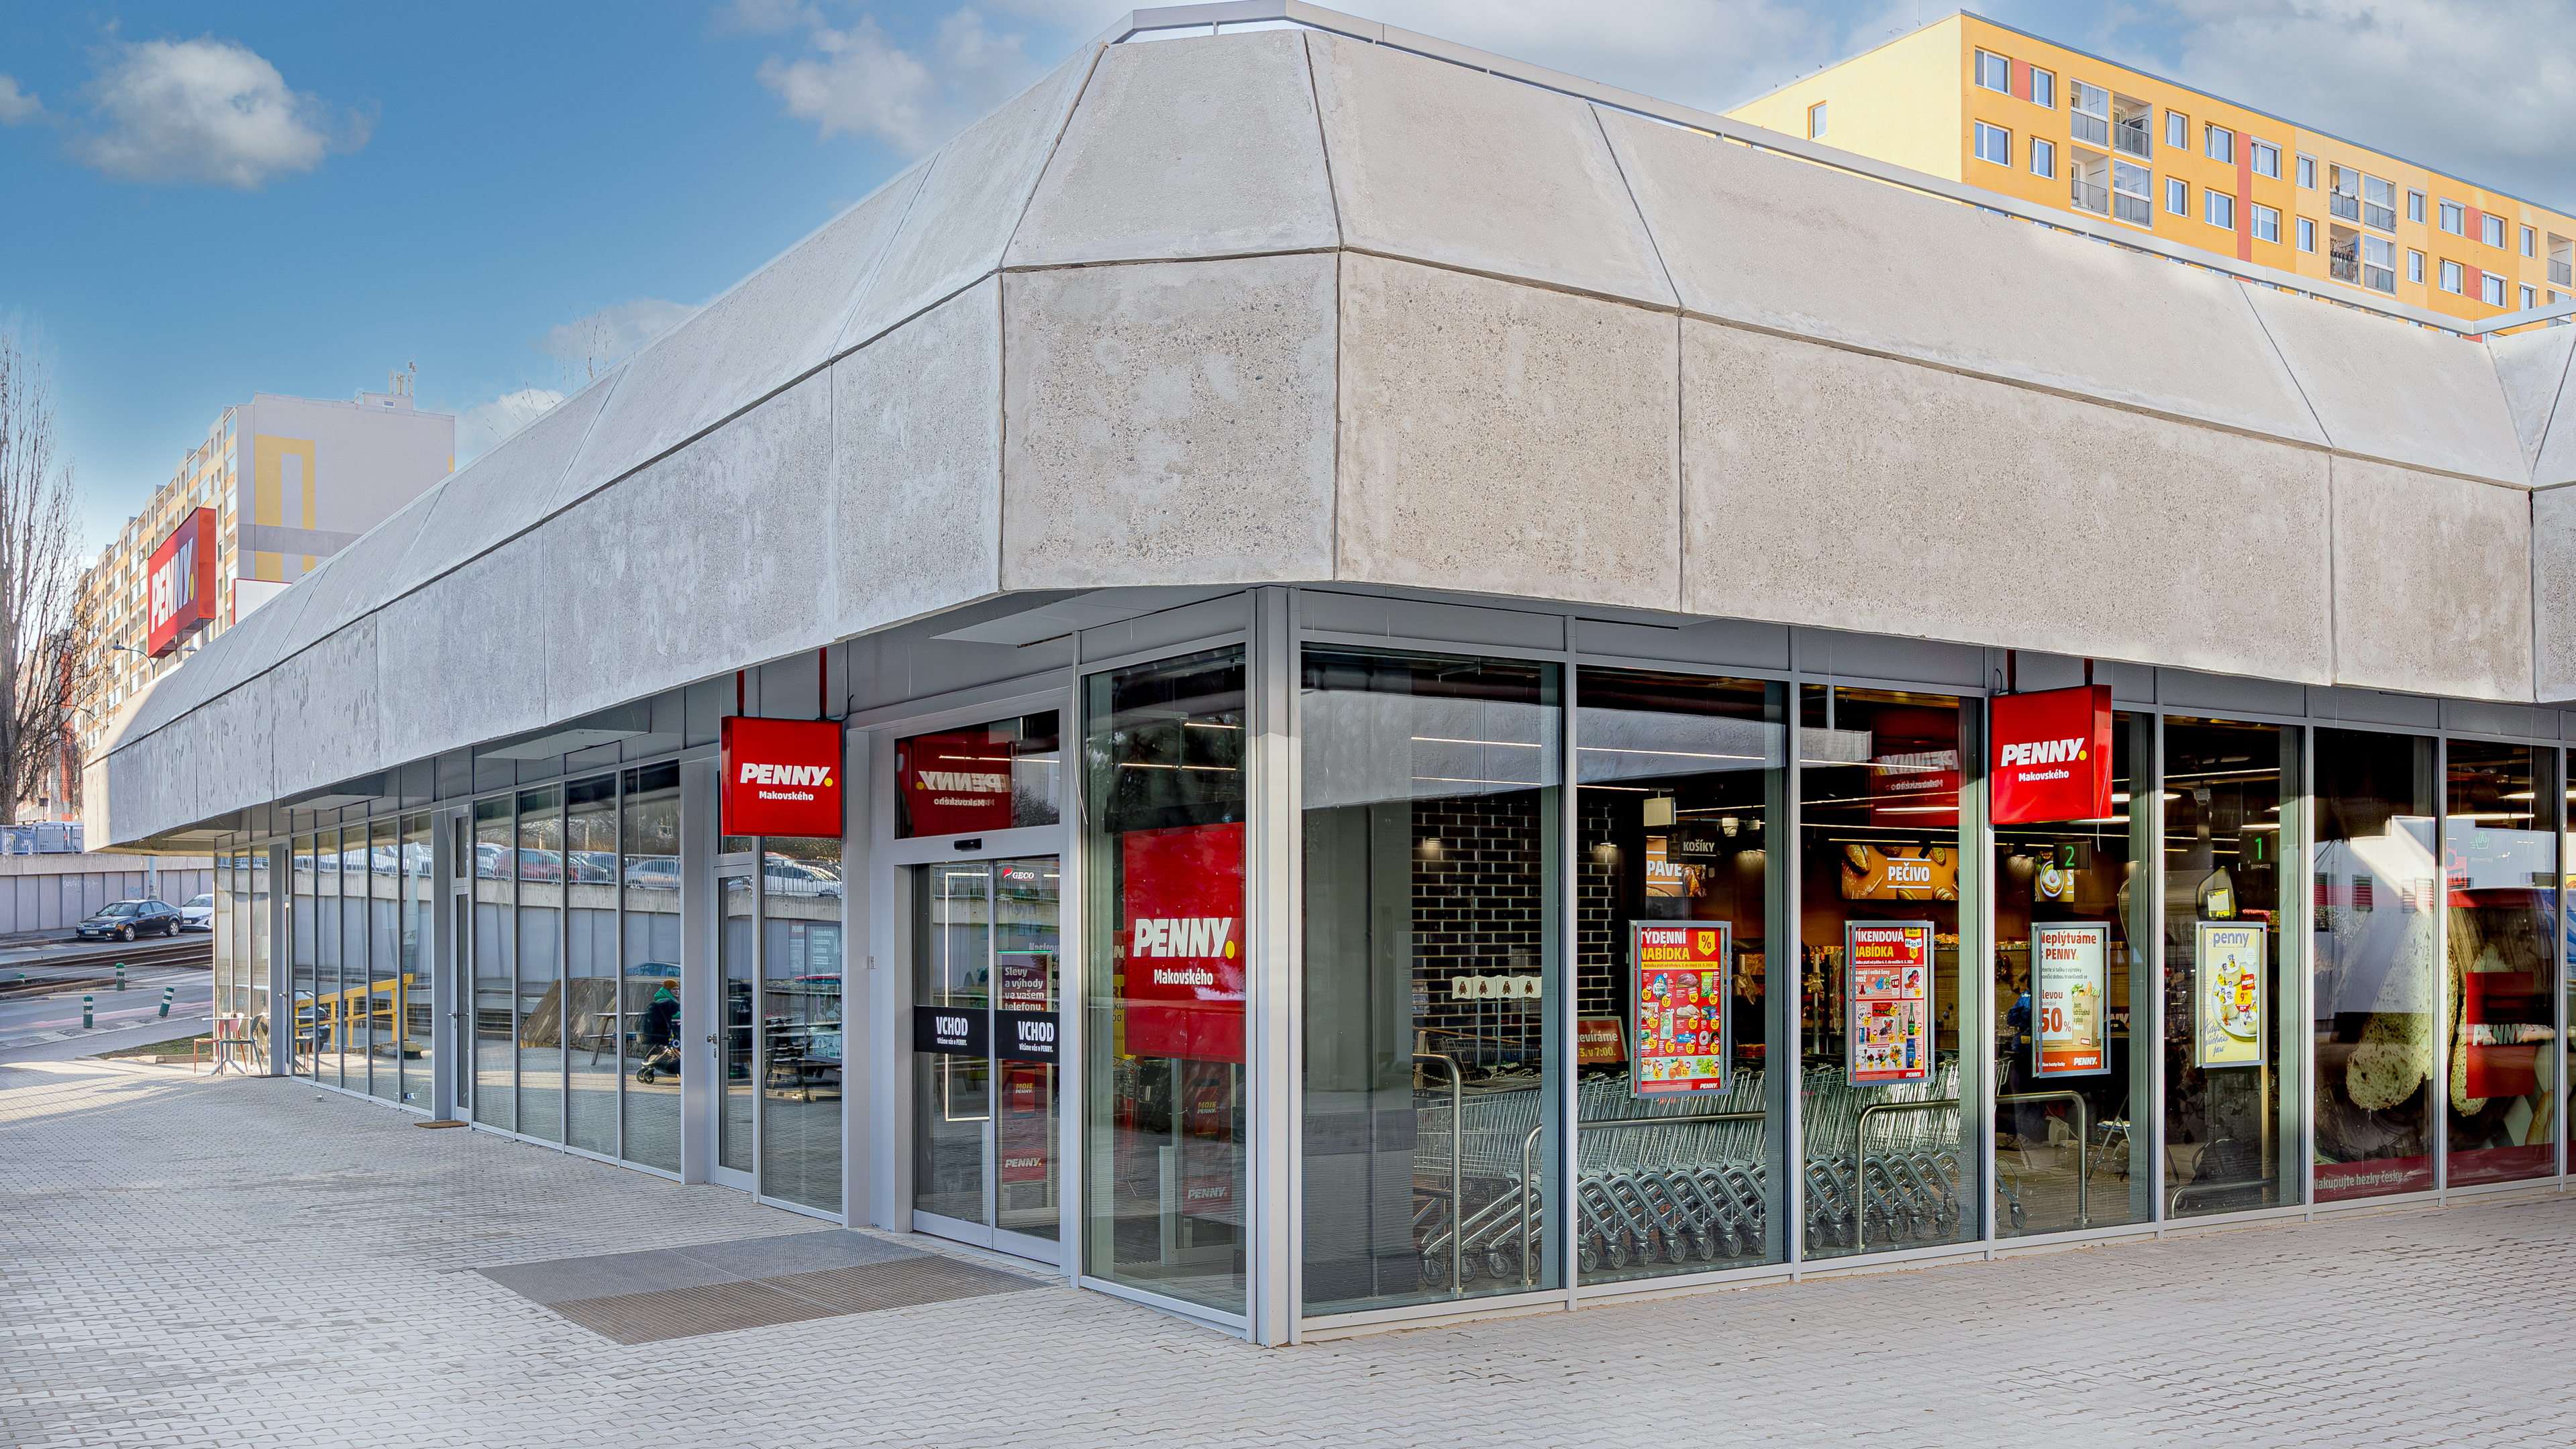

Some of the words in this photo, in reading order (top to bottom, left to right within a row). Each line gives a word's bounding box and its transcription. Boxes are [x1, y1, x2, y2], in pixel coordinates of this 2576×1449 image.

[2018, 769, 2069, 782] Makovského
[759, 790, 814, 801] Makovského
[1683, 839, 1715, 852] KOŠÍKY
[2255, 837, 2261, 860] 1
[2065, 846, 2074, 867] 2
[1013, 871, 1034, 879] GECO
[1888, 862, 1930, 882] PEČIVO
[2041, 930, 2096, 947] Neplýtváme
[1004, 967, 1027, 977] Slevy
[1154, 967, 1213, 985] Makovského
[1012, 978, 1043, 989] výhody
[1017, 989, 1044, 1000] vašem
[2042, 990, 2063, 1000] levou
[1004, 1003, 1044, 1011] telefonu.
[936, 1016, 968, 1036] VCHOD
[1018, 1021, 1054, 1042] VCHOD
[1019, 1043, 1031, 1051] Vítáme
[2314, 1174, 2355, 1190] Nakupujte
[2356, 1172, 2380, 1186] hezky
